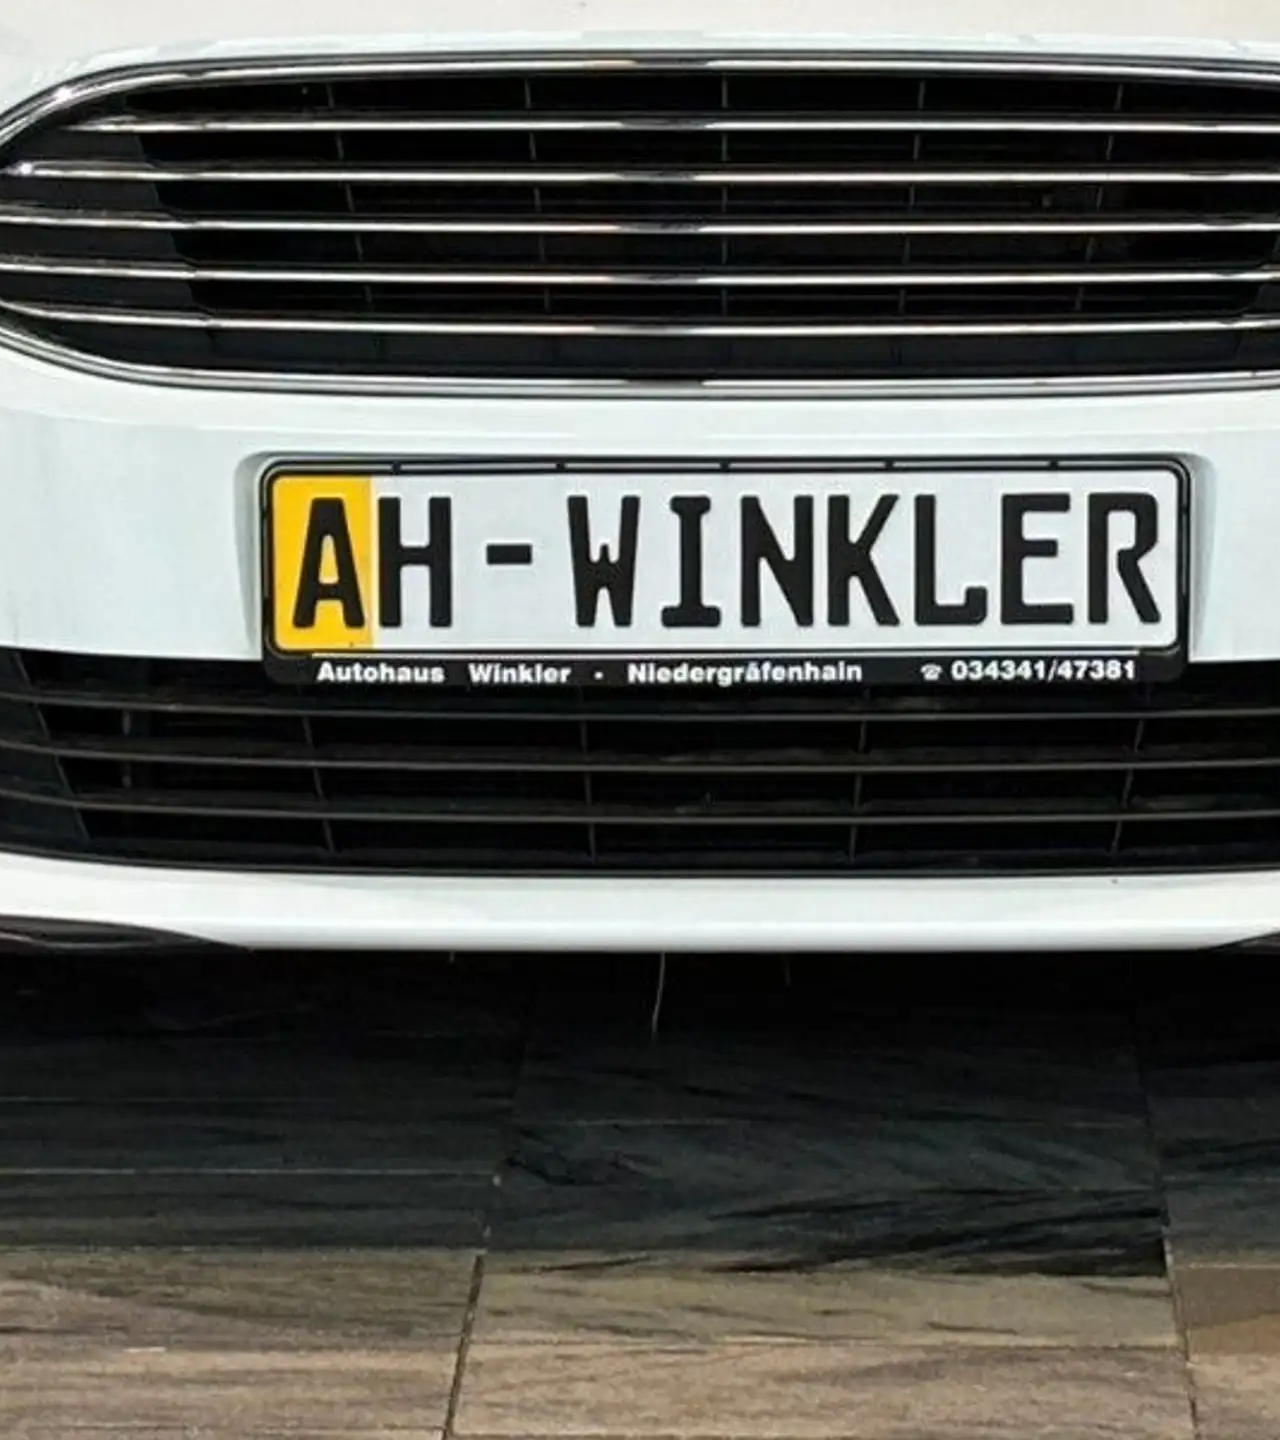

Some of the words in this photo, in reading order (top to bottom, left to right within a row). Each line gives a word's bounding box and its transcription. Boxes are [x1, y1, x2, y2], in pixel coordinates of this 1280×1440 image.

[317, 661, 445, 684] Autohaus
[467, 661, 572, 684] Winkler
[627, 661, 863, 687] Niedergräfenhain
[950, 659, 1135, 681] 034341/47381
